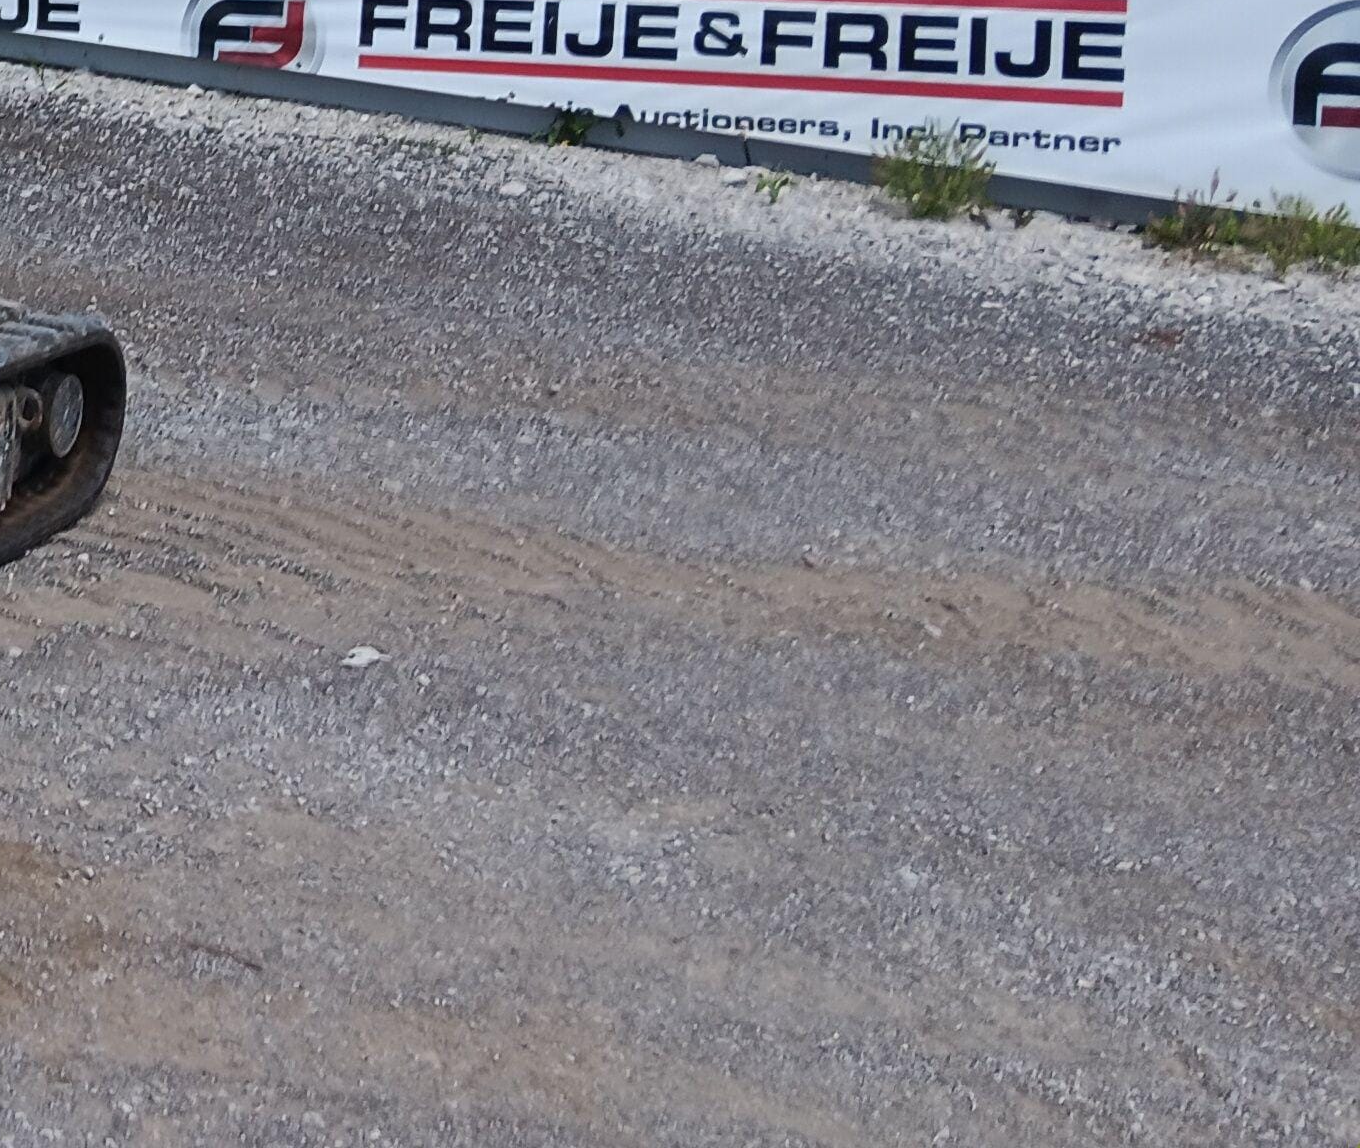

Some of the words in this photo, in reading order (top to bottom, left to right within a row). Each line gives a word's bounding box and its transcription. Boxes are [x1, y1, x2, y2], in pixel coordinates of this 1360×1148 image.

[693, 11, 749, 57] &
[760, 9, 1126, 83] FREIJE
[959, 123, 1123, 154] Partner
